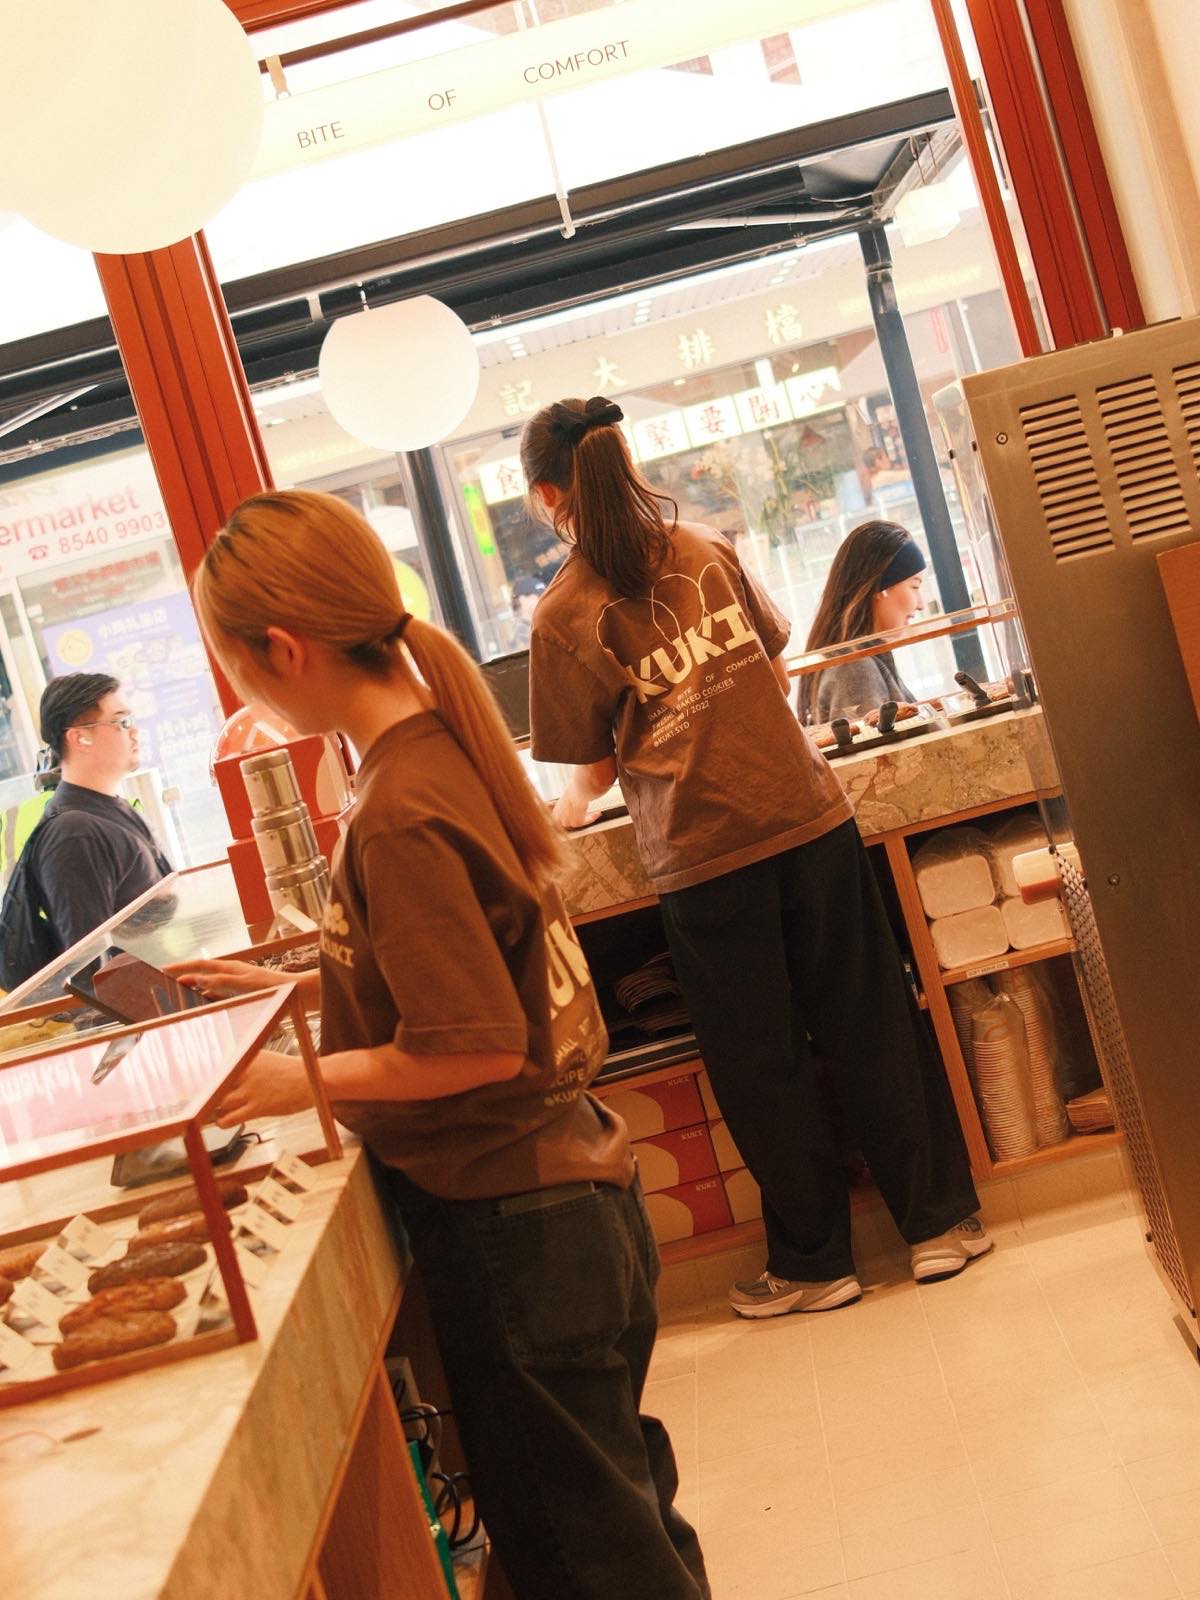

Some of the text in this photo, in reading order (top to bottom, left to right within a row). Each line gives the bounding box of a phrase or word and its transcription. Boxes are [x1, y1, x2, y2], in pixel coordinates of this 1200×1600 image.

[297, 40, 630, 149] BITE OF COMFORT
[59, 512, 165, 554] 8540 9903
[626, 602, 757, 705] KUKI
[705, 673, 715, 683] OF
[725, 651, 764, 674] COMFORT
[676, 693, 701, 712] BAKED
[702, 677, 735, 697] COOKIES
[691, 701, 710, 714] 2022
